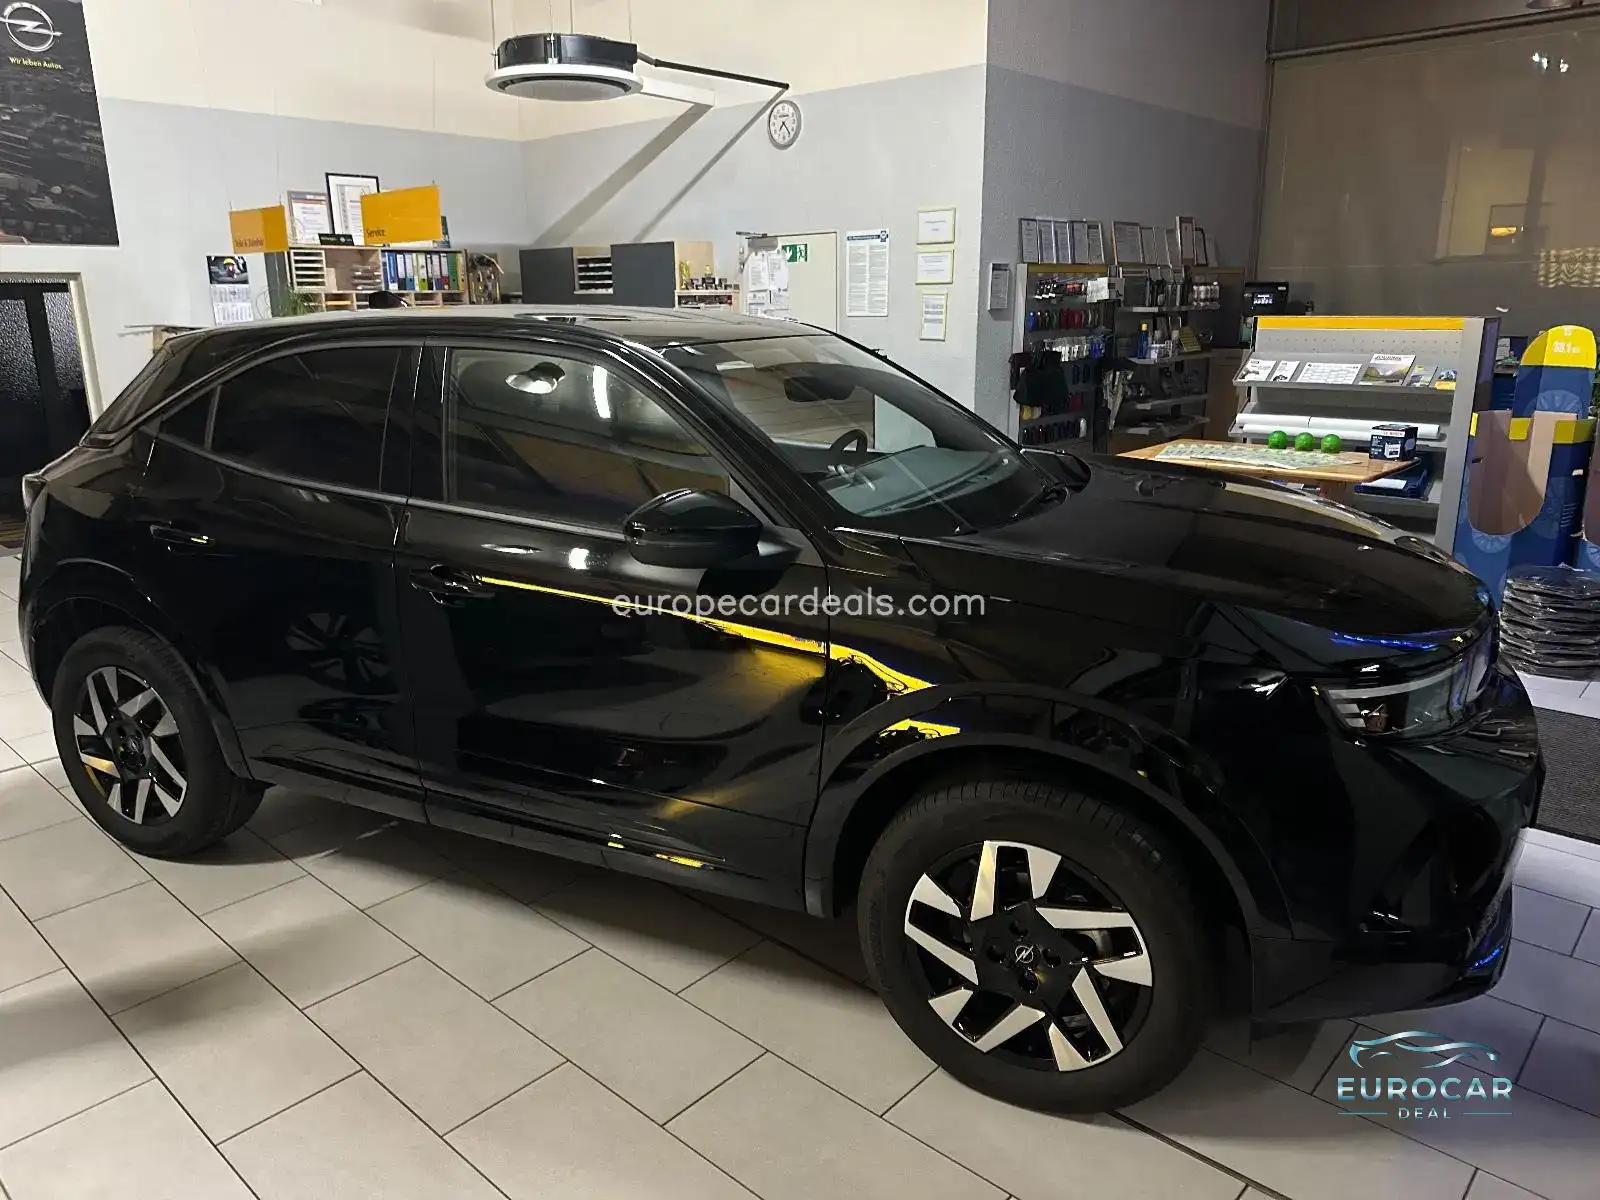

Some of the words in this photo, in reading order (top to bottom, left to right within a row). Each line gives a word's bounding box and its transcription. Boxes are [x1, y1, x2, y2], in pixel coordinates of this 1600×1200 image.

[9, 57, 21, 65] Wir
[22, 58, 42, 67] leben
[43, 60, 64, 70] Autos.
[366, 227, 386, 238] Service
